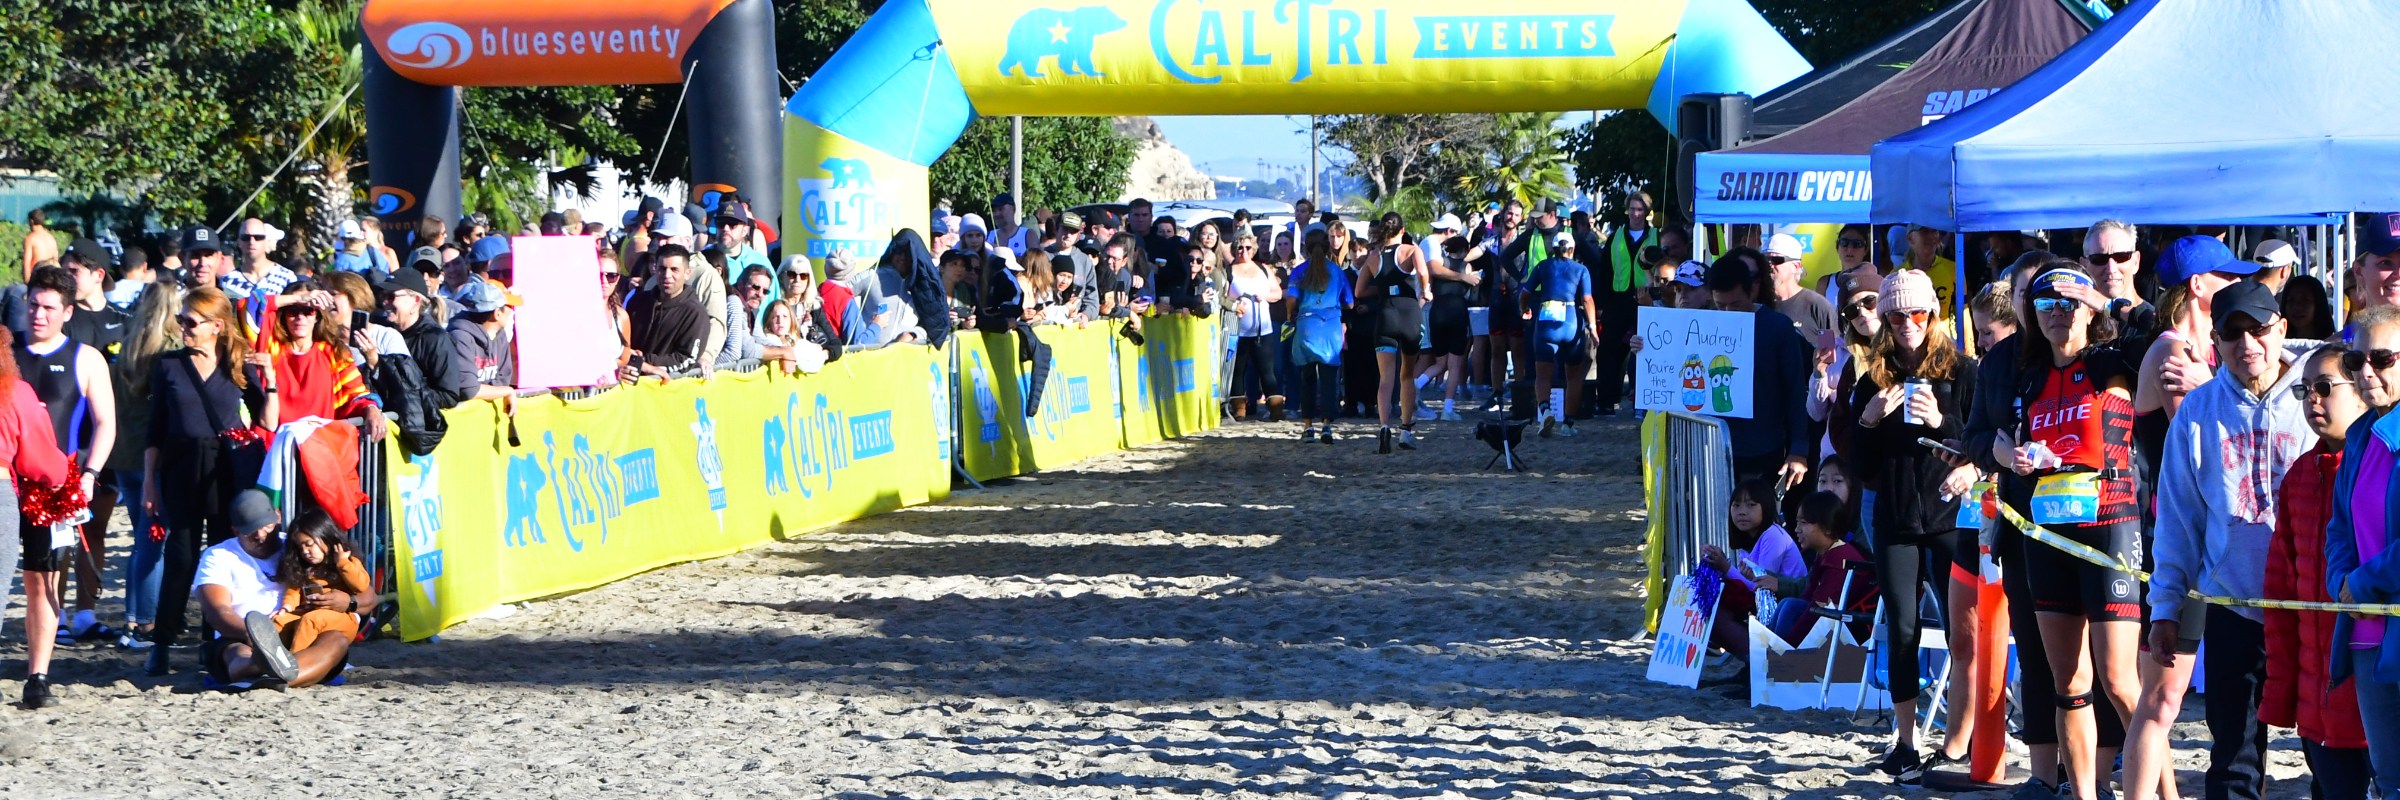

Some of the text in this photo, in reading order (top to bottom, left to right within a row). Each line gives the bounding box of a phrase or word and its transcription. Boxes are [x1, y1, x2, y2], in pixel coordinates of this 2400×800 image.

[481, 24, 681, 59] blueseventy
[1433, 20, 1598, 51] EVENTS
[1647, 319, 1743, 354] Go Audrey!
[1643, 388, 1676, 406] BEST
[1652, 376, 1667, 388] the
[2031, 403, 2092, 431] ELITE
[853, 416, 891, 453] EVENTS
[623, 456, 656, 497] EVENTS
